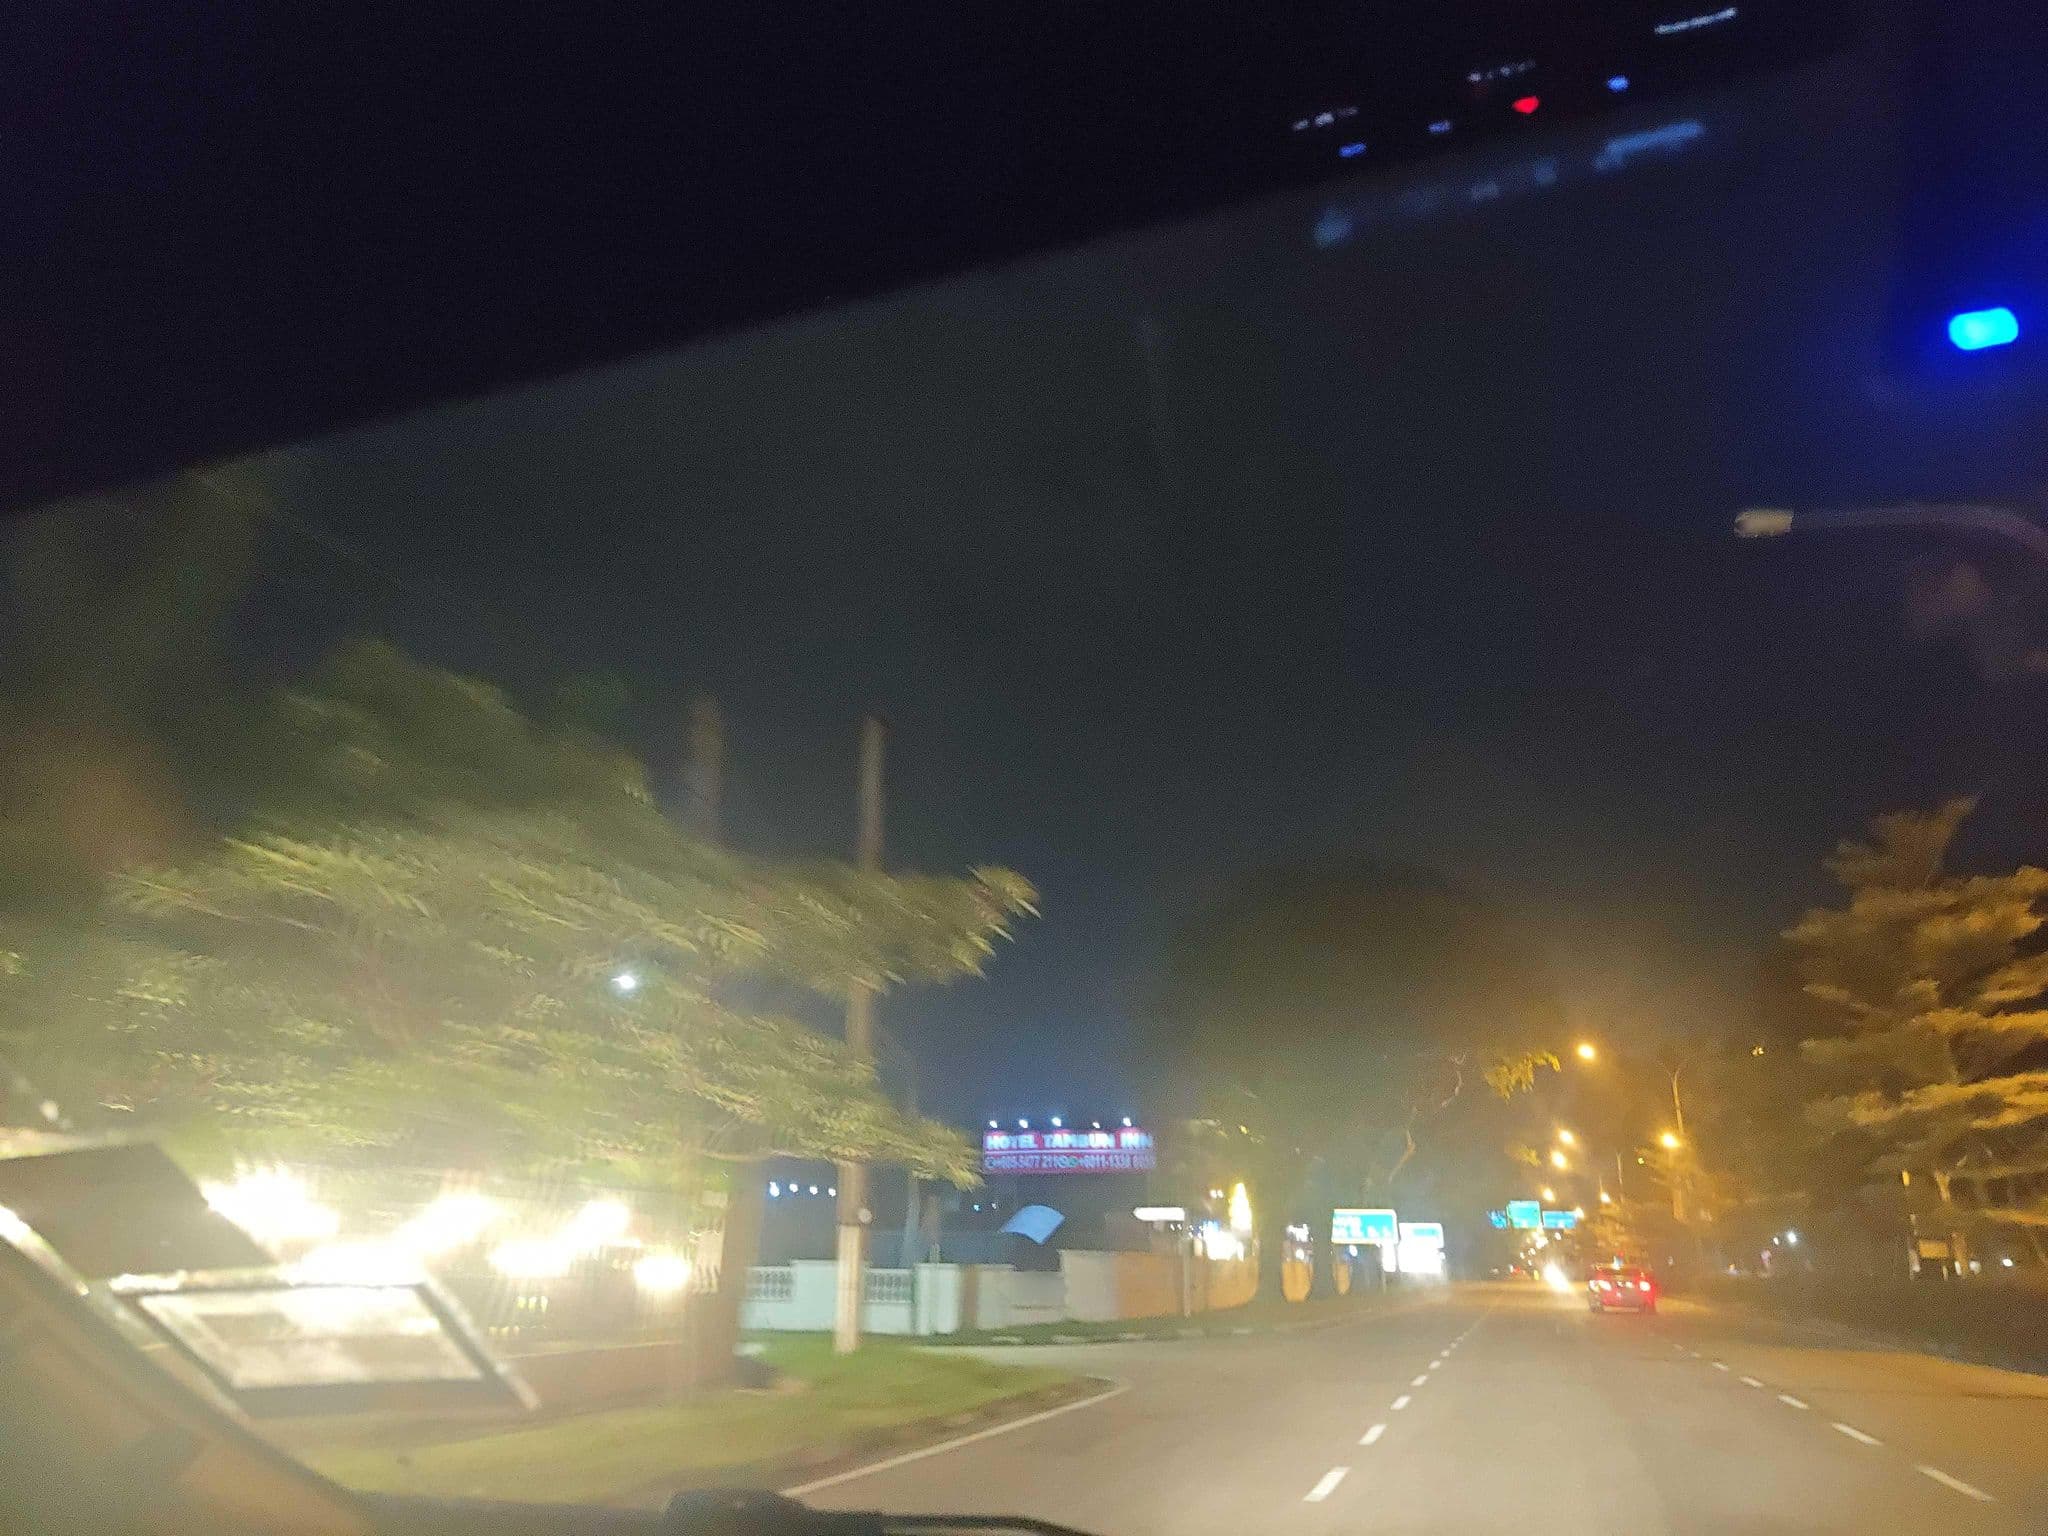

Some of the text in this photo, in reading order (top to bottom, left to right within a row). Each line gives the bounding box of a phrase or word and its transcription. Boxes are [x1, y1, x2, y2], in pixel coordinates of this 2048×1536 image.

[986, 1132, 1153, 1149] HOTEL TAMBUN INN
